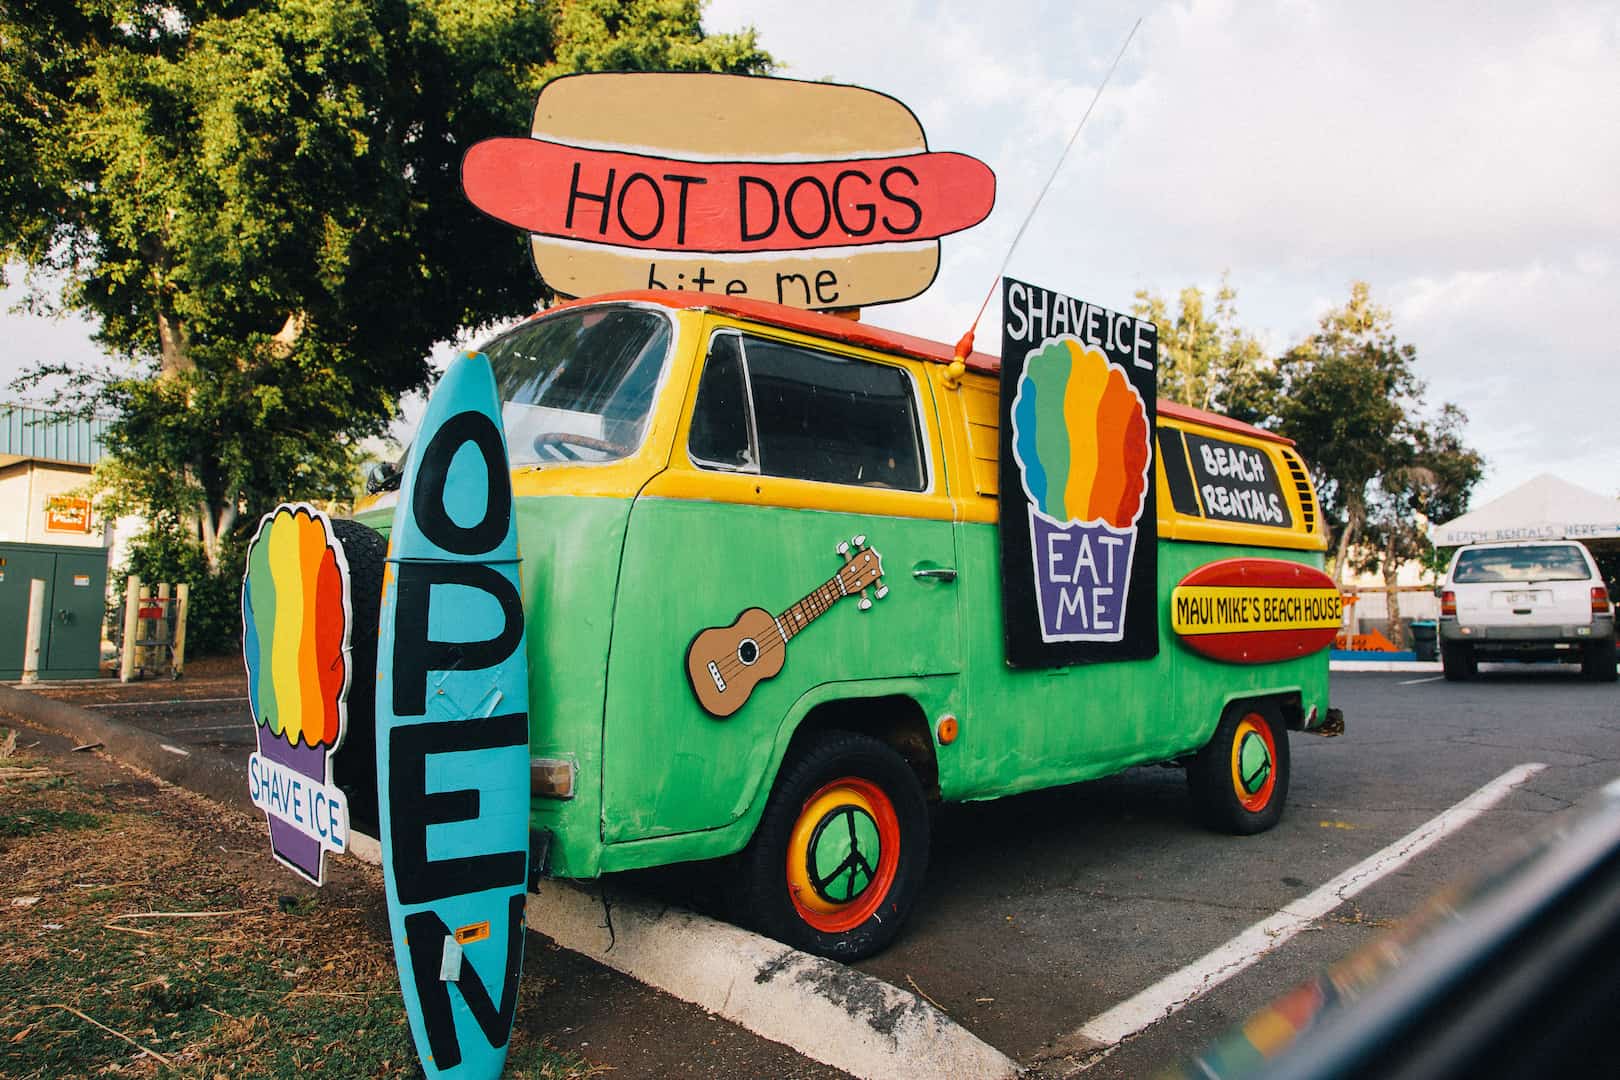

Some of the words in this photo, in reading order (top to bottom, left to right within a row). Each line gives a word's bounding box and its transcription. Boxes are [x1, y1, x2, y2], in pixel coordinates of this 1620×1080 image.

[565, 162, 708, 245] HOT
[738, 166, 922, 243] DOGS
[776, 270, 839, 304] me
[1007, 283, 1104, 346] SHAVE
[1104, 309, 1155, 371] ICE
[1200, 444, 1266, 483] BEACH
[1202, 484, 1284, 524] RENTALS
[1496, 525, 1554, 541] RENTALS
[1563, 523, 1599, 537] HERE
[1048, 532, 1124, 585] EAT
[1056, 586, 1114, 631] ME
[1177, 597, 1214, 625] MAUI
[1217, 596, 1262, 625] MIKE'S
[1264, 598, 1302, 622] BEACH
[1304, 596, 1342, 621] HOUSE
[389, 410, 529, 1071] OPEN
[250, 756, 304, 825] SHAVE
[308, 787, 344, 848] ICE
